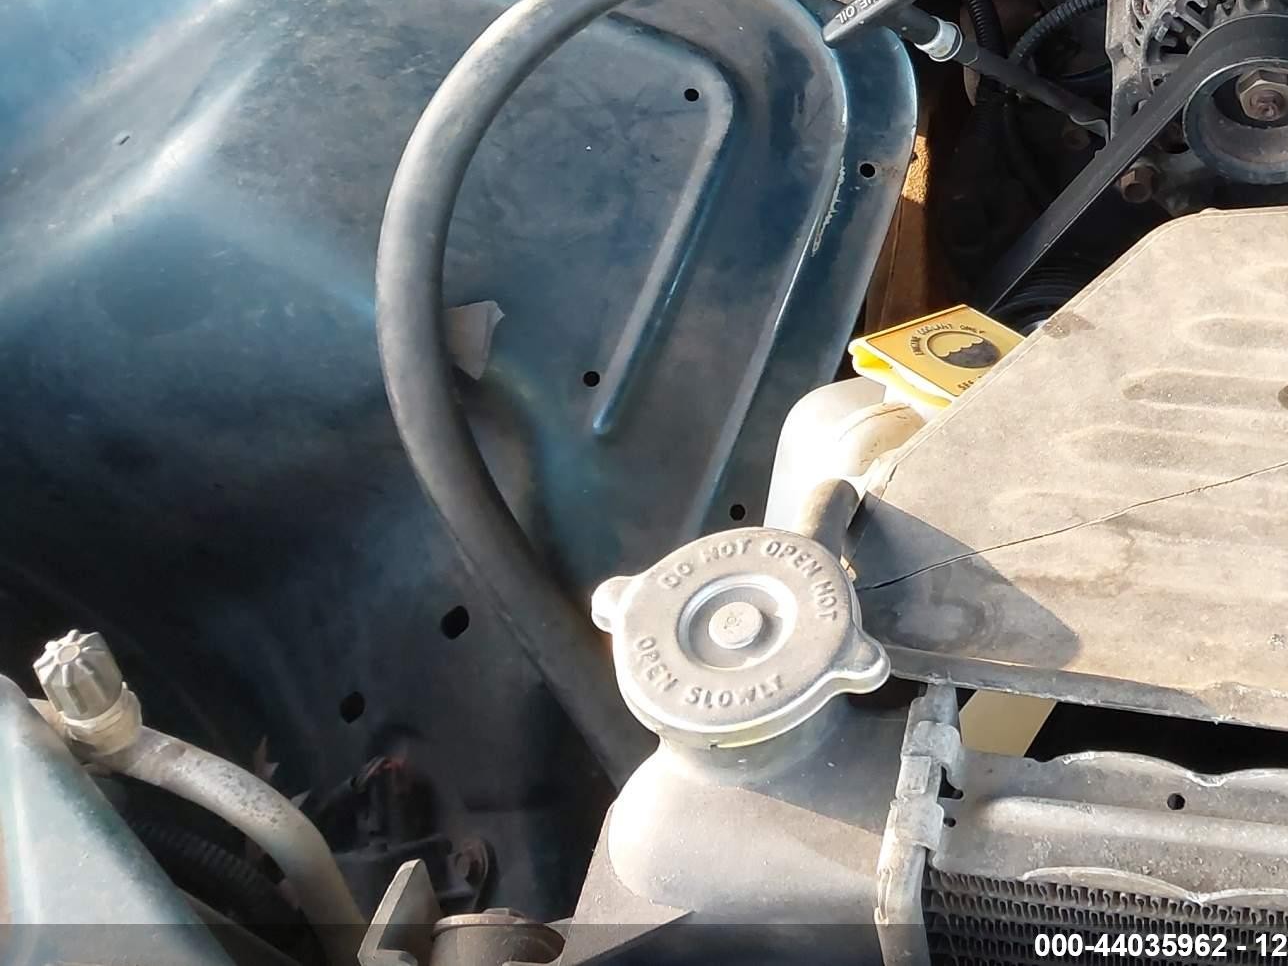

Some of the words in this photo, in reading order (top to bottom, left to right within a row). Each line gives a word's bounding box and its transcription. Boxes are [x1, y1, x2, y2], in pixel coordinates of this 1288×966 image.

[835, 5, 858, 25] OIL
[660, 564, 694, 589] DO
[702, 537, 753, 563] NOT
[764, 539, 823, 579] OPEN
[811, 580, 838, 622] HOT
[635, 636, 679, 691] OPEN
[684, 673, 784, 708] SLOWLY
